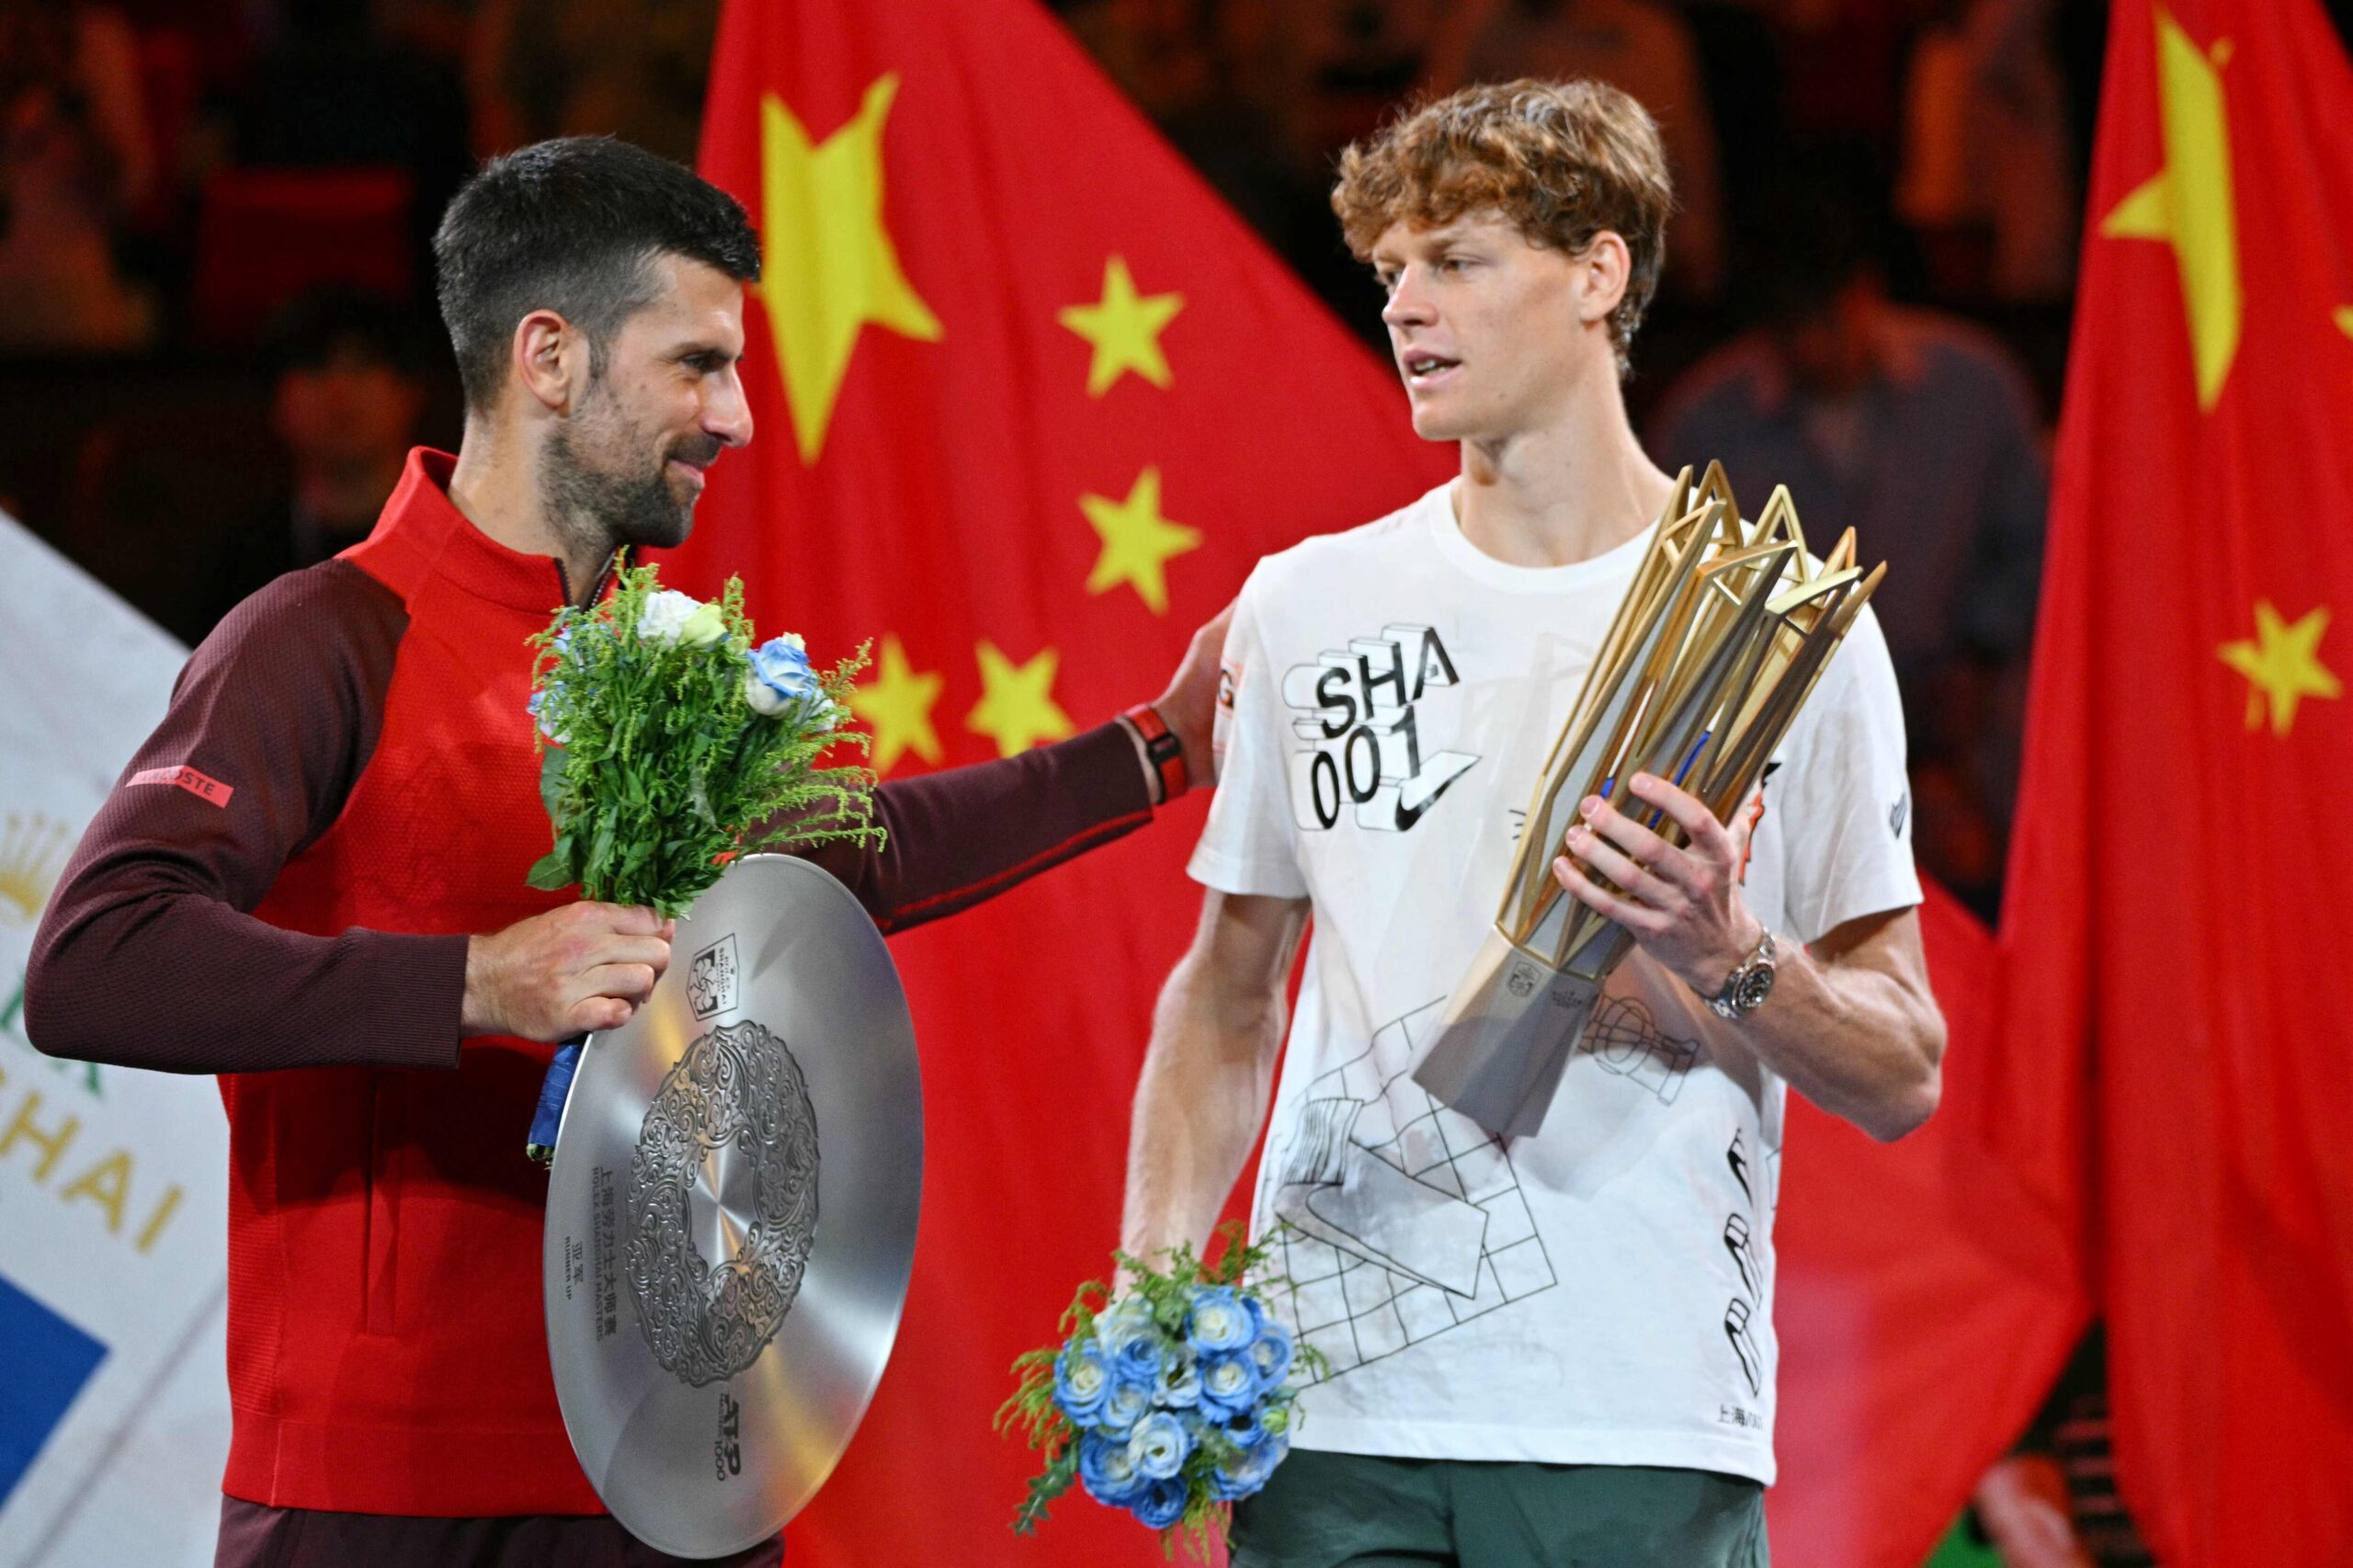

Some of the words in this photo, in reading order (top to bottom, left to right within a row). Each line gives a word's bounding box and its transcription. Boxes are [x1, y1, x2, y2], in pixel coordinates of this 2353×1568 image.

[1316, 626, 1460, 739] SHA
[1311, 703, 1421, 829] 001
[591, 1166, 600, 1208] ROLEX
[572, 1241, 584, 1285] 亚军
[594, 1213, 602, 1278] SHANGHAI
[602, 1165, 617, 1337] 上海劳力士大师赛
[565, 1285, 572, 1301] UP
[595, 1283, 604, 1342] MASTERS
[714, 1440, 726, 1482] 1000
[723, 1393, 741, 1475] ATP
